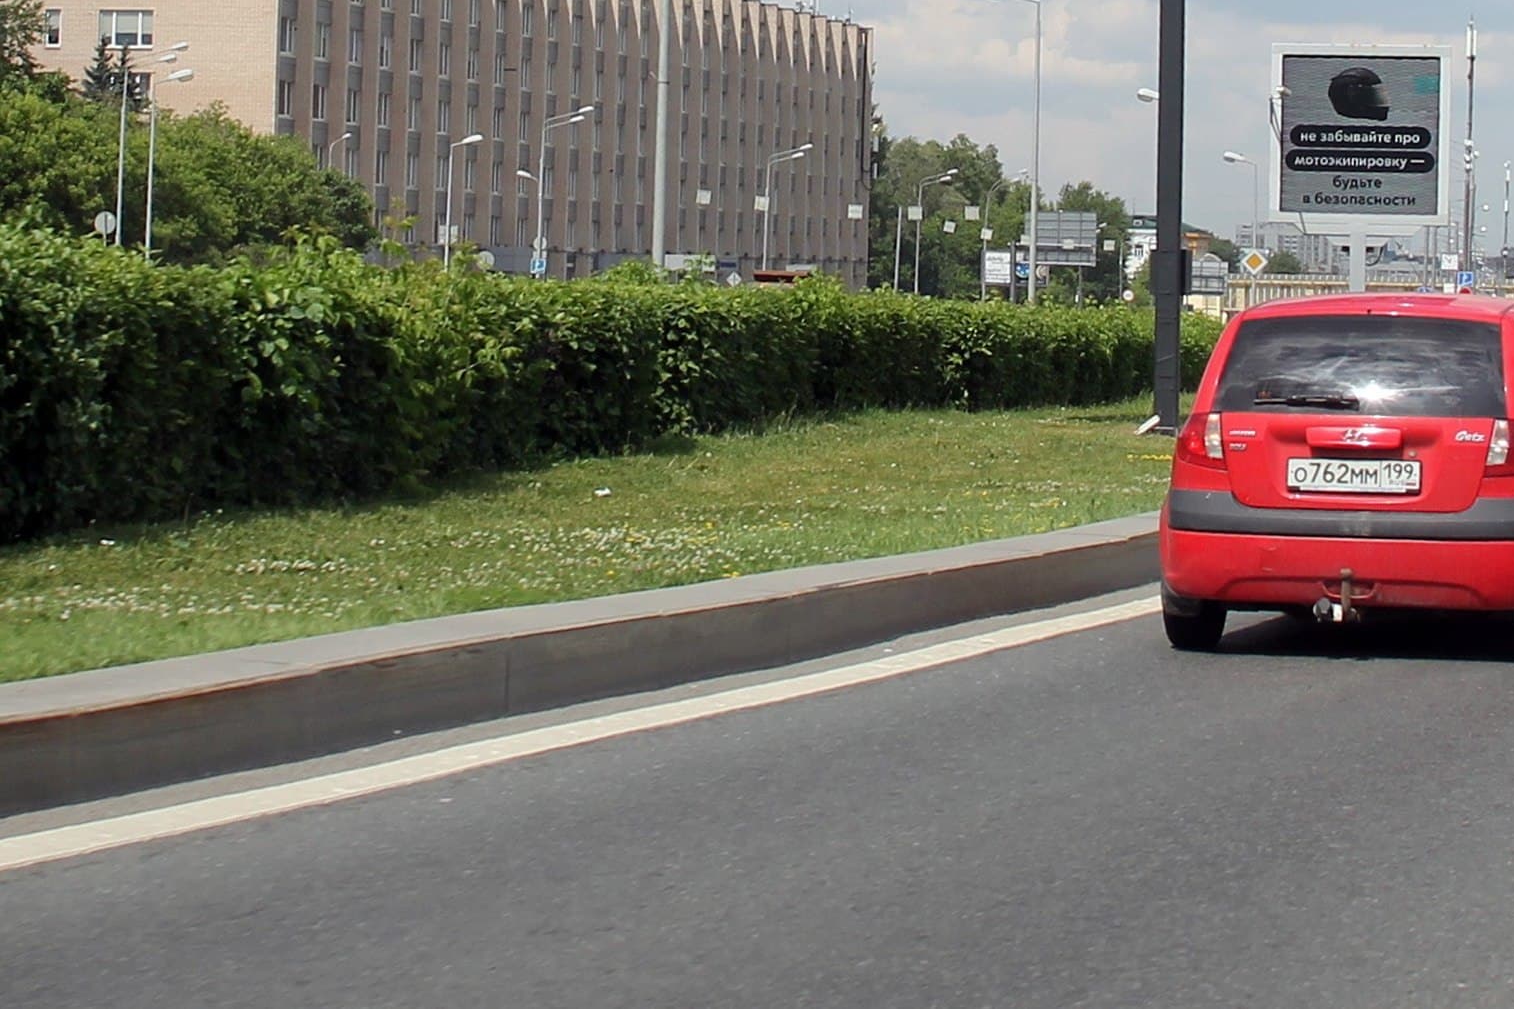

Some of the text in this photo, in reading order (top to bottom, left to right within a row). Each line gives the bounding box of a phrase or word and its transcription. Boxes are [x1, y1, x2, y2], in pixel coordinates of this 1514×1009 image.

[1300, 129, 1421, 146] не забывайте про
[1294, 155, 1408, 170] мотоэкипировку
[1332, 174, 1383, 191] будьте
[1302, 191, 1416, 206] в безопасности
